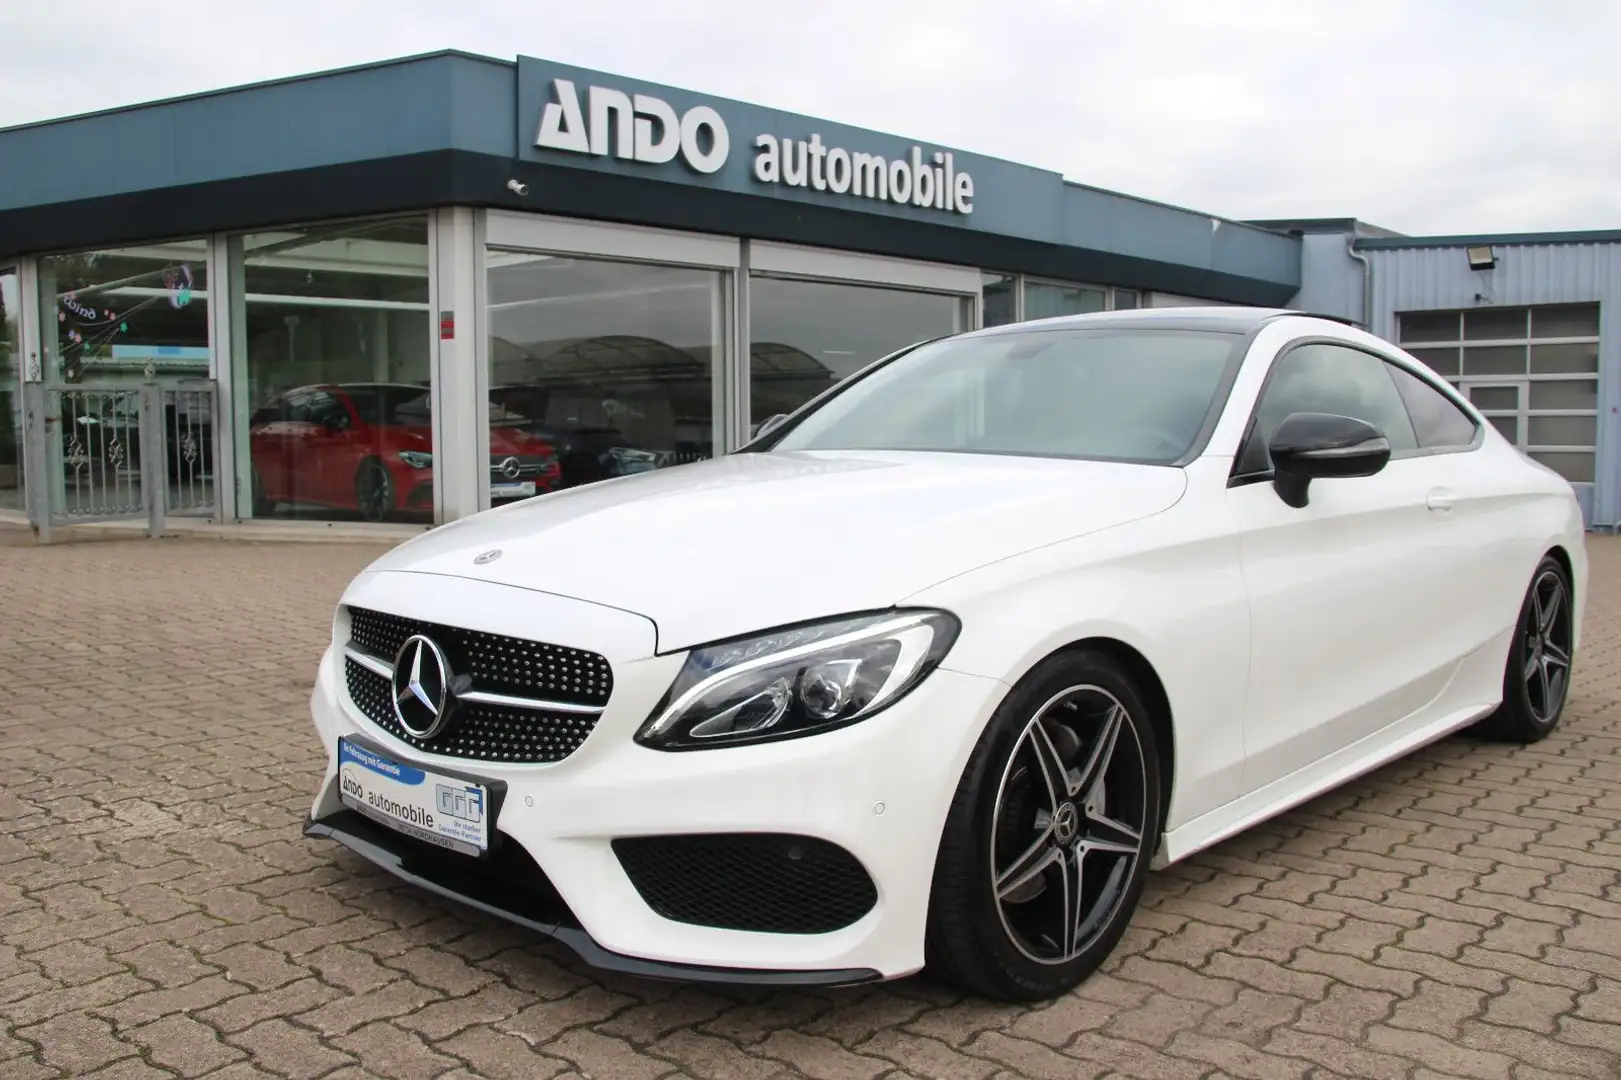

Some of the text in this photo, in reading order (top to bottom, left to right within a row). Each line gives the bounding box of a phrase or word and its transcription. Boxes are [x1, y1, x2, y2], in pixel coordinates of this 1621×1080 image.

[534, 78, 974, 215] ANDO automobile
[368, 790, 434, 828] automobile
